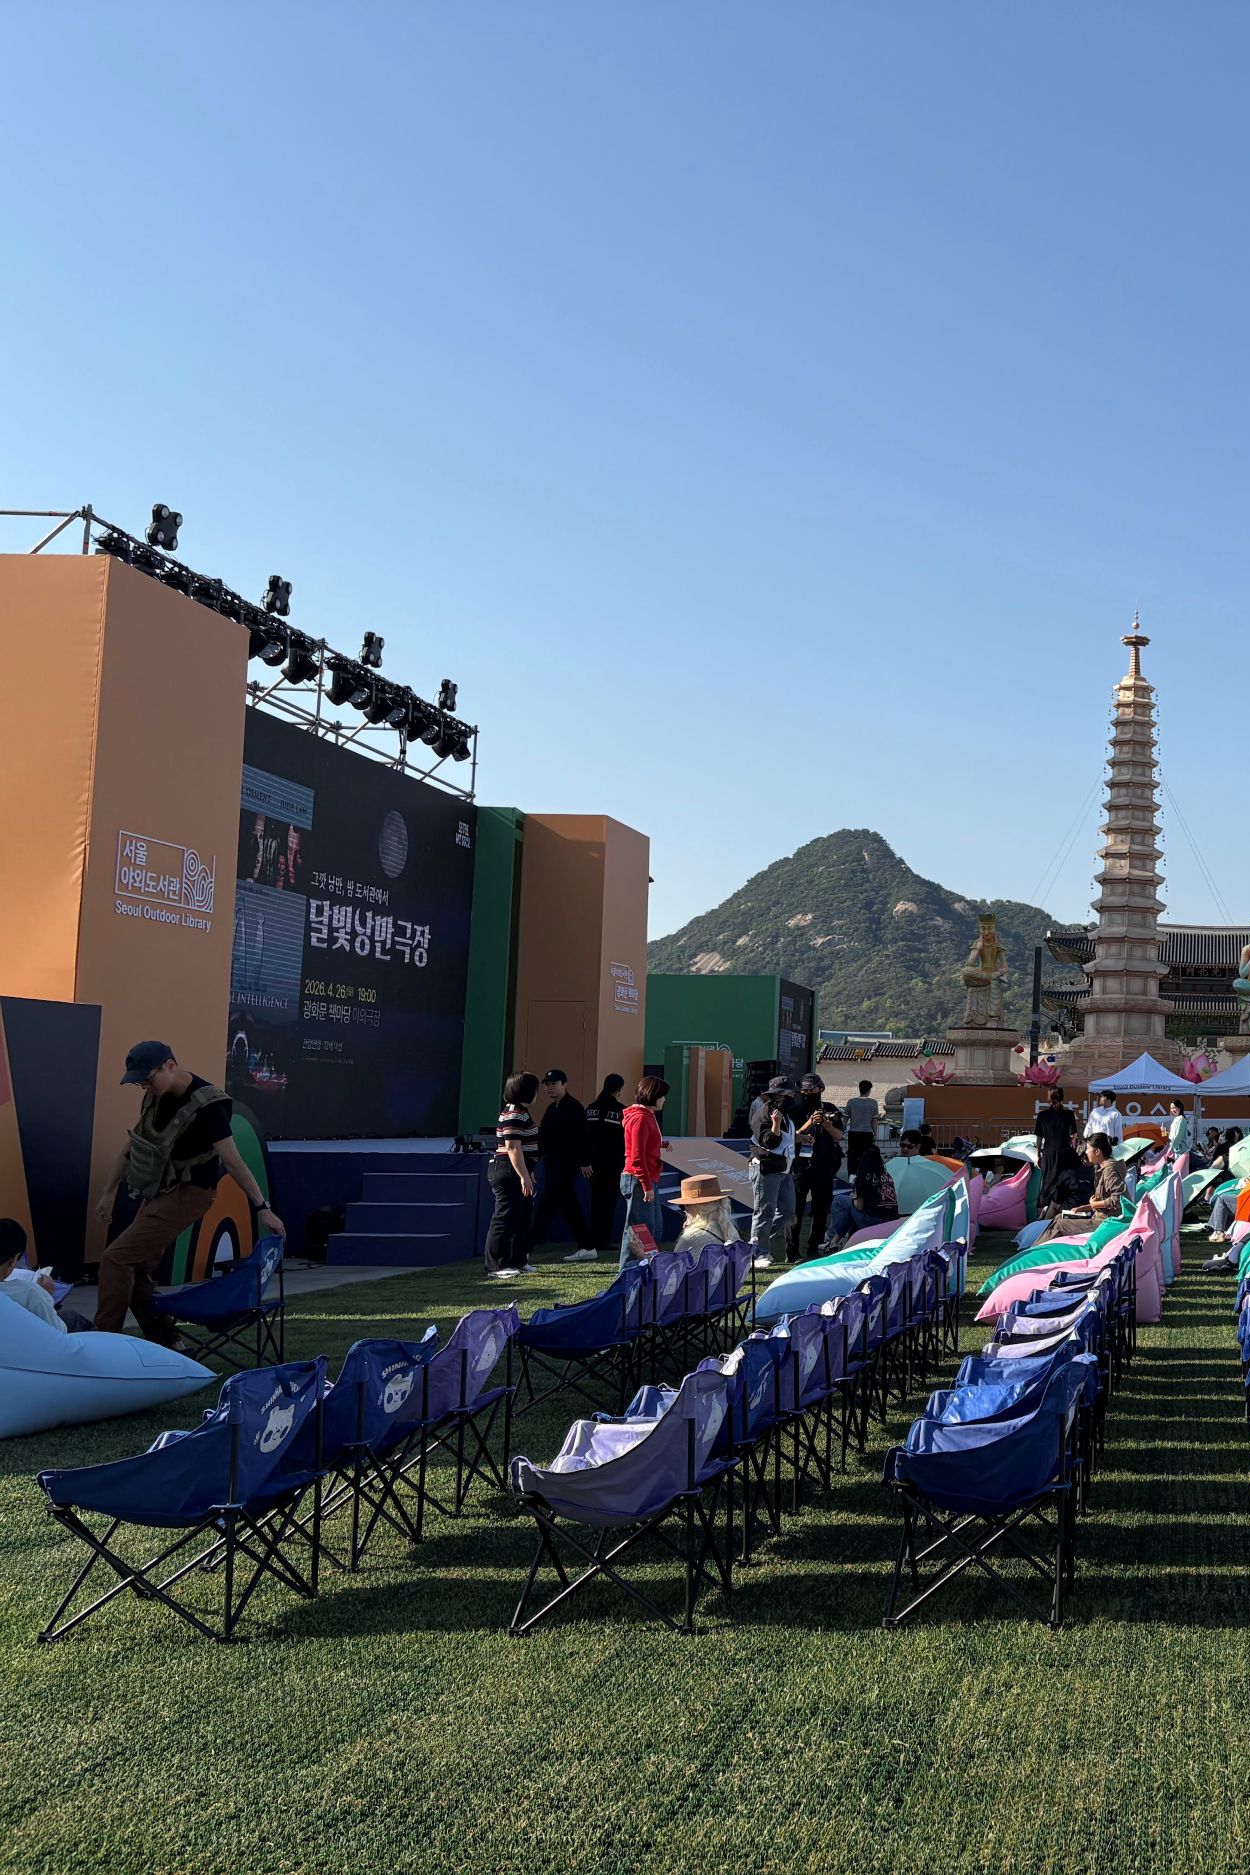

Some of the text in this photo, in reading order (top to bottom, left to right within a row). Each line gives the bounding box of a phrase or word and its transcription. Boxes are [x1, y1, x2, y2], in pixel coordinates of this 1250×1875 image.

[123, 839, 148, 866] 서울
[121, 866, 181, 900] 야외도서관
[346, 880, 354, 897] 밤
[355, 883, 390, 907] 도서관에서
[115, 899, 212, 933] Seoul Outdoor Library
[309, 898, 432, 968] 달빛낭만극장
[237, 992, 289, 1009] INTELLIGENCE
[358, 987, 377, 1003] 19:00
[303, 1000, 328, 1021] 광화문
[328, 1003, 352, 1024] 책마당
